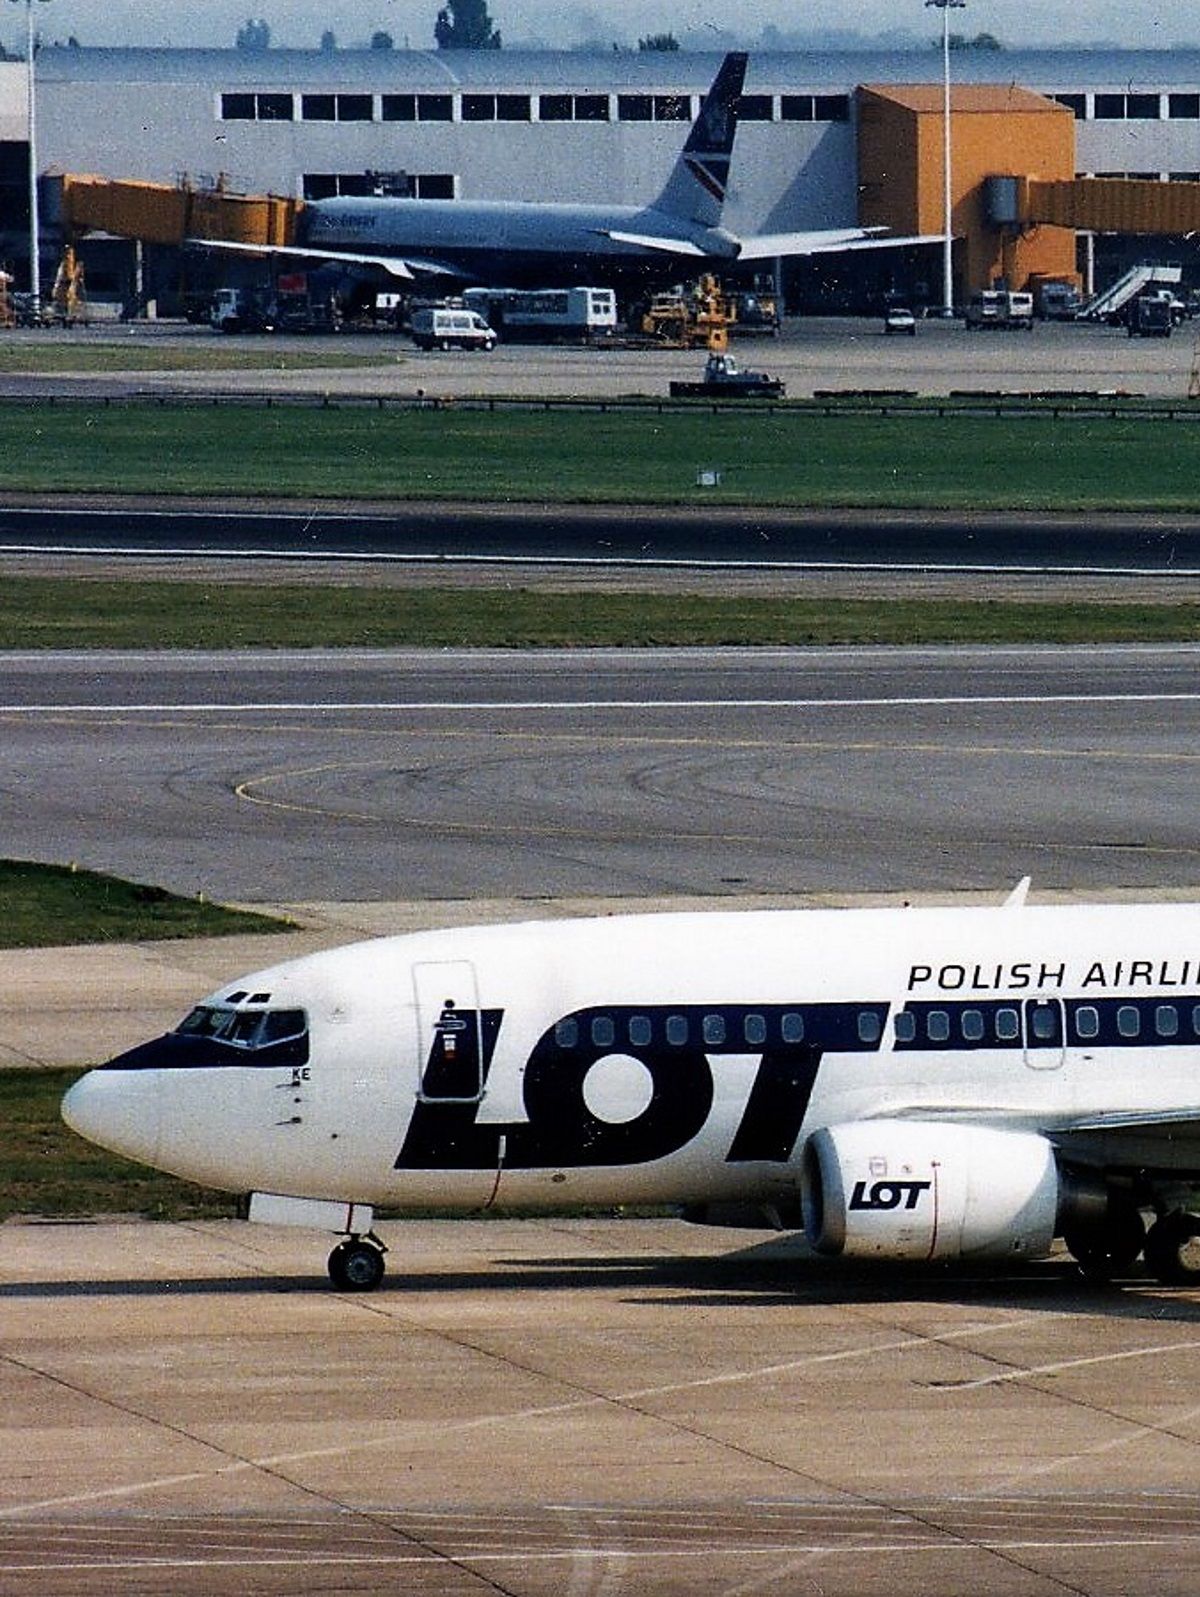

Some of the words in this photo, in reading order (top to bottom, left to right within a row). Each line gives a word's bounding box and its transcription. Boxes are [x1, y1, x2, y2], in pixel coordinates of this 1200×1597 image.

[907, 962, 1065, 991] POLISH
[292, 1067, 311, 1080] KE
[394, 1001, 891, 1170] LOT
[848, 1181, 931, 1211] LOT
